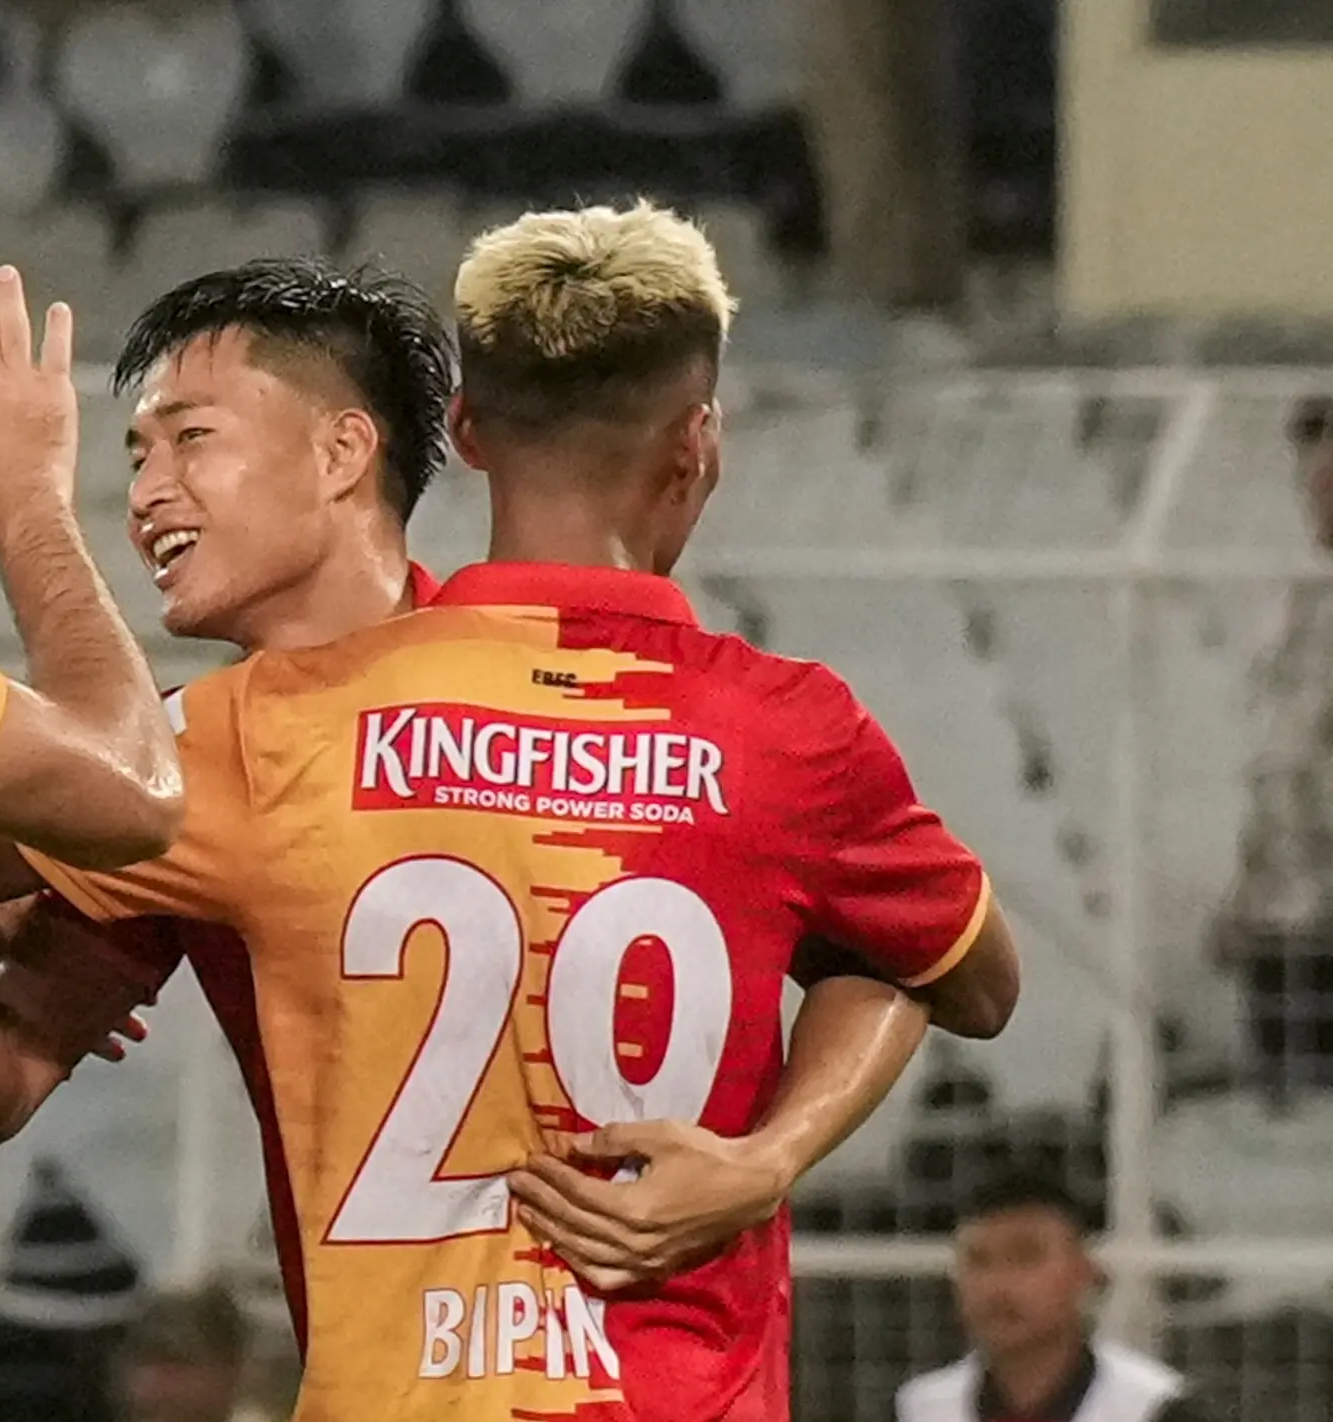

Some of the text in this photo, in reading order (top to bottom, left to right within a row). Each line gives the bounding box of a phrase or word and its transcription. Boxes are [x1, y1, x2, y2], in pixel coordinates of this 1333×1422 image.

[360, 708, 729, 815] KINGFISHER
[435, 786, 695, 825] STRONG POWER SODA
[418, 1280, 621, 1380] BIPIN
